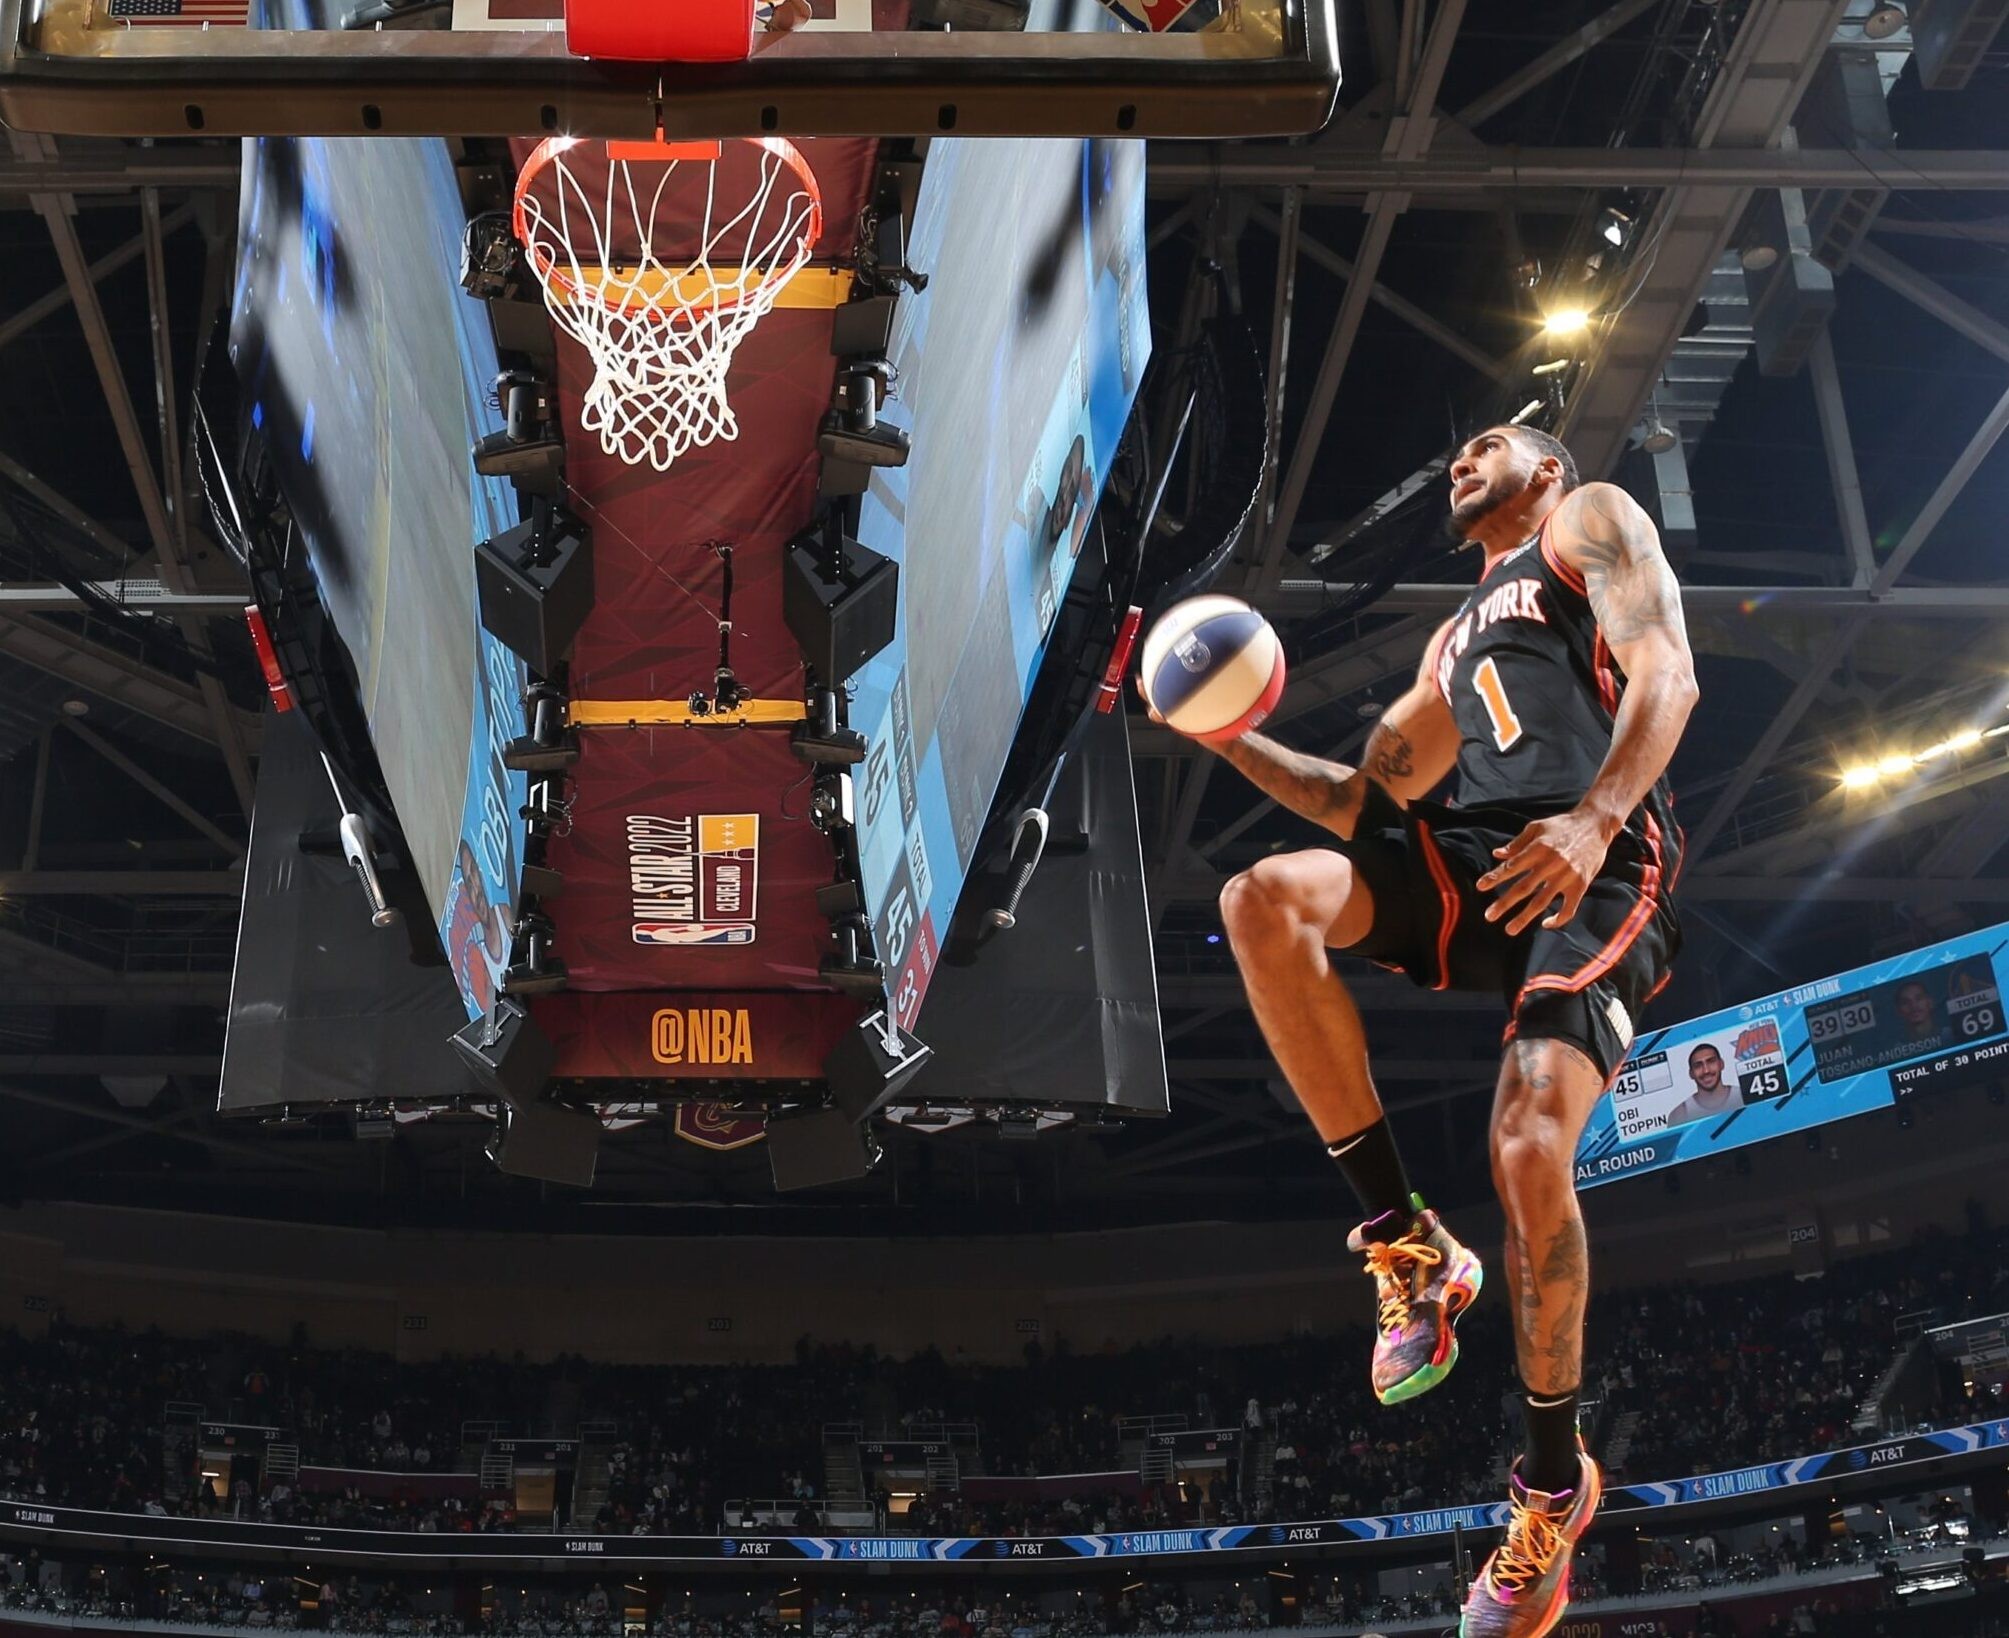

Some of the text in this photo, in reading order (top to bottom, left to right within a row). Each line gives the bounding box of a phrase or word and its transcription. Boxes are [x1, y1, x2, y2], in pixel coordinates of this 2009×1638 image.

[1477, 578, 1547, 634] YORK
[1471, 655, 1523, 753] 1
[864, 738, 889, 827] 45
[481, 764, 511, 888] OBI
[911, 832, 926, 898] TOTAL
[716, 865, 740, 911] CLEVELAND
[886, 885, 913, 967] 45
[1755, 1000, 1780, 1015] AT&T
[1811, 1016, 1838, 1038] 39
[1843, 1006, 1871, 1028] 30
[1961, 1008, 1995, 1036] 69
[651, 1008, 753, 1064] @NBA
[1744, 1056, 1775, 1070] TOTAL
[1817, 1045, 1853, 1065] JUAN
[1896, 1066, 1929, 1082] TOTAL
[1935, 1060, 1949, 1072] OF
[1954, 1055, 1969, 1067] 30
[1615, 1075, 1639, 1096] 45
[1749, 1070, 1780, 1096] 45
[1618, 1107, 1639, 1122] OBI
[1620, 1114, 1668, 1137] TOPPIN
[1600, 1146, 1656, 1174] ROUND
[1792, 1227, 1816, 1242] 204
[1870, 1445, 1905, 1464] AT&T
[1705, 1468, 1769, 1498] SLAM DUNK
[1288, 1527, 1321, 1541] AT&T
[1414, 1512, 1442, 1534] SLAM
[739, 1543, 771, 1555] AT&T
[860, 1540, 918, 1558] SLAM DUNK
[1011, 1543, 1044, 1555] AT&T
[1133, 1532, 1193, 1553] SLAM DUNK
